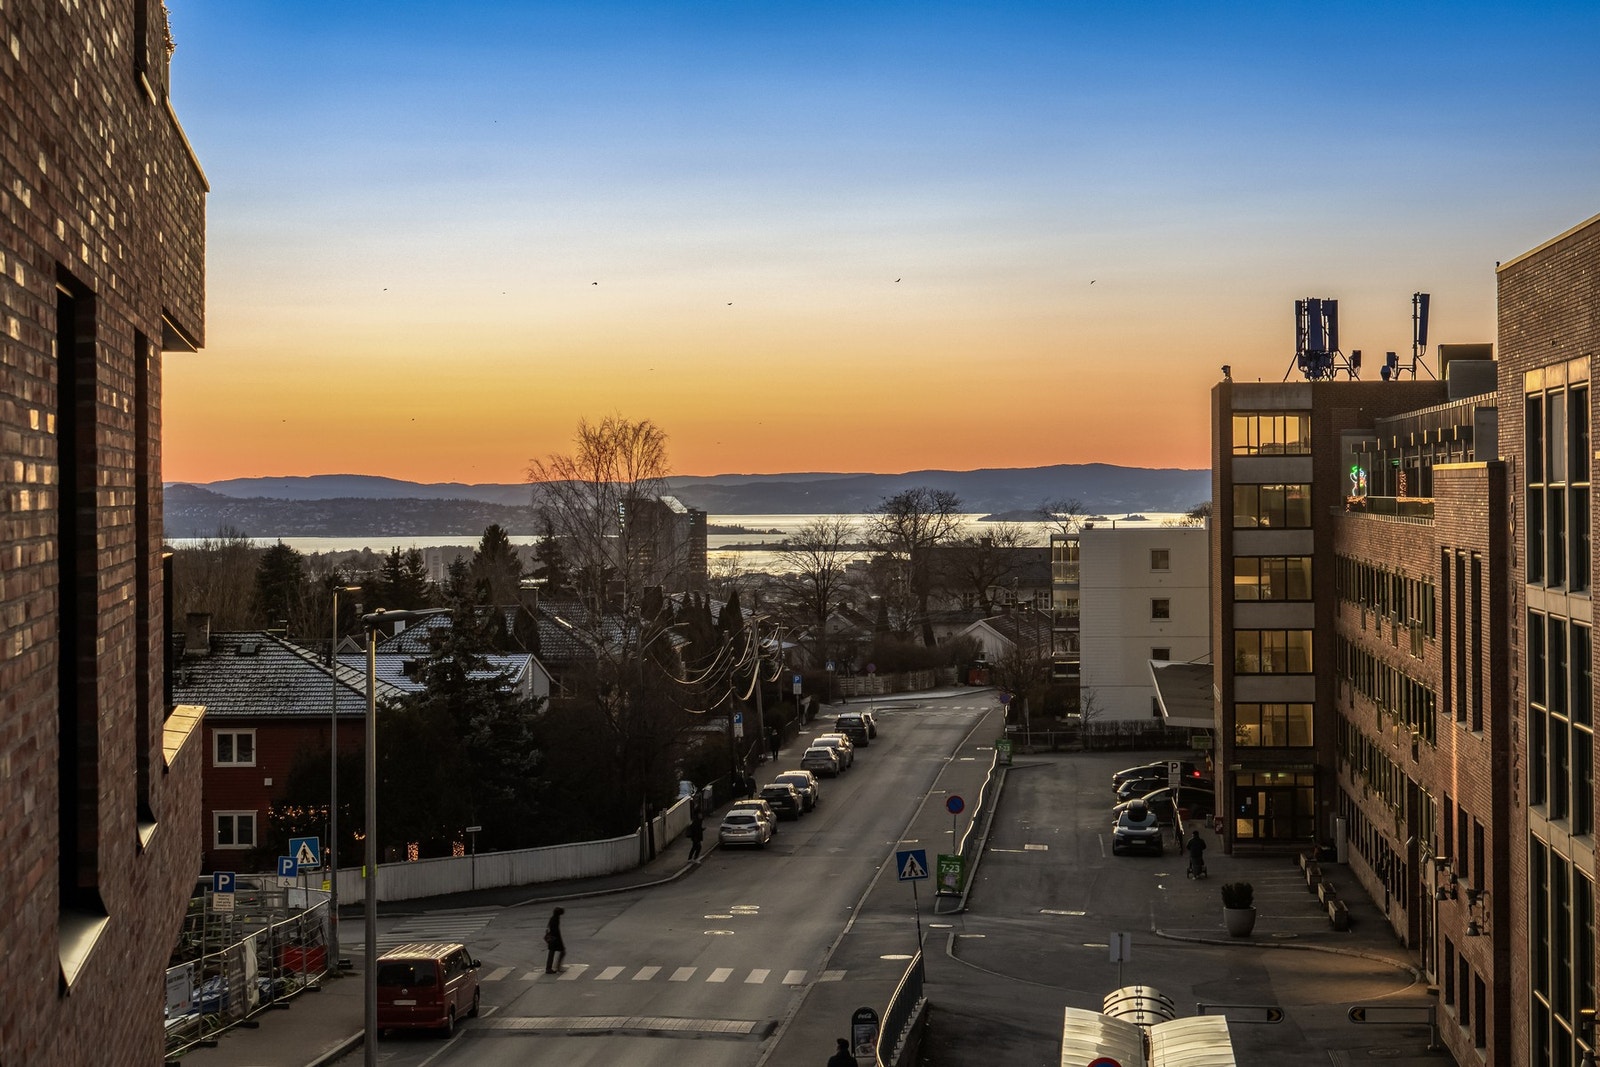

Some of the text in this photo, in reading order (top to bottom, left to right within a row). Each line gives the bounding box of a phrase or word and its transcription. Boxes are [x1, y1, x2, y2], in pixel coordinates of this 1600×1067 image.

[1171, 763, 1179, 773] P
[282, 859, 293, 875] P
[940, 864, 960, 873] 7-23
[218, 874, 230, 891] P
